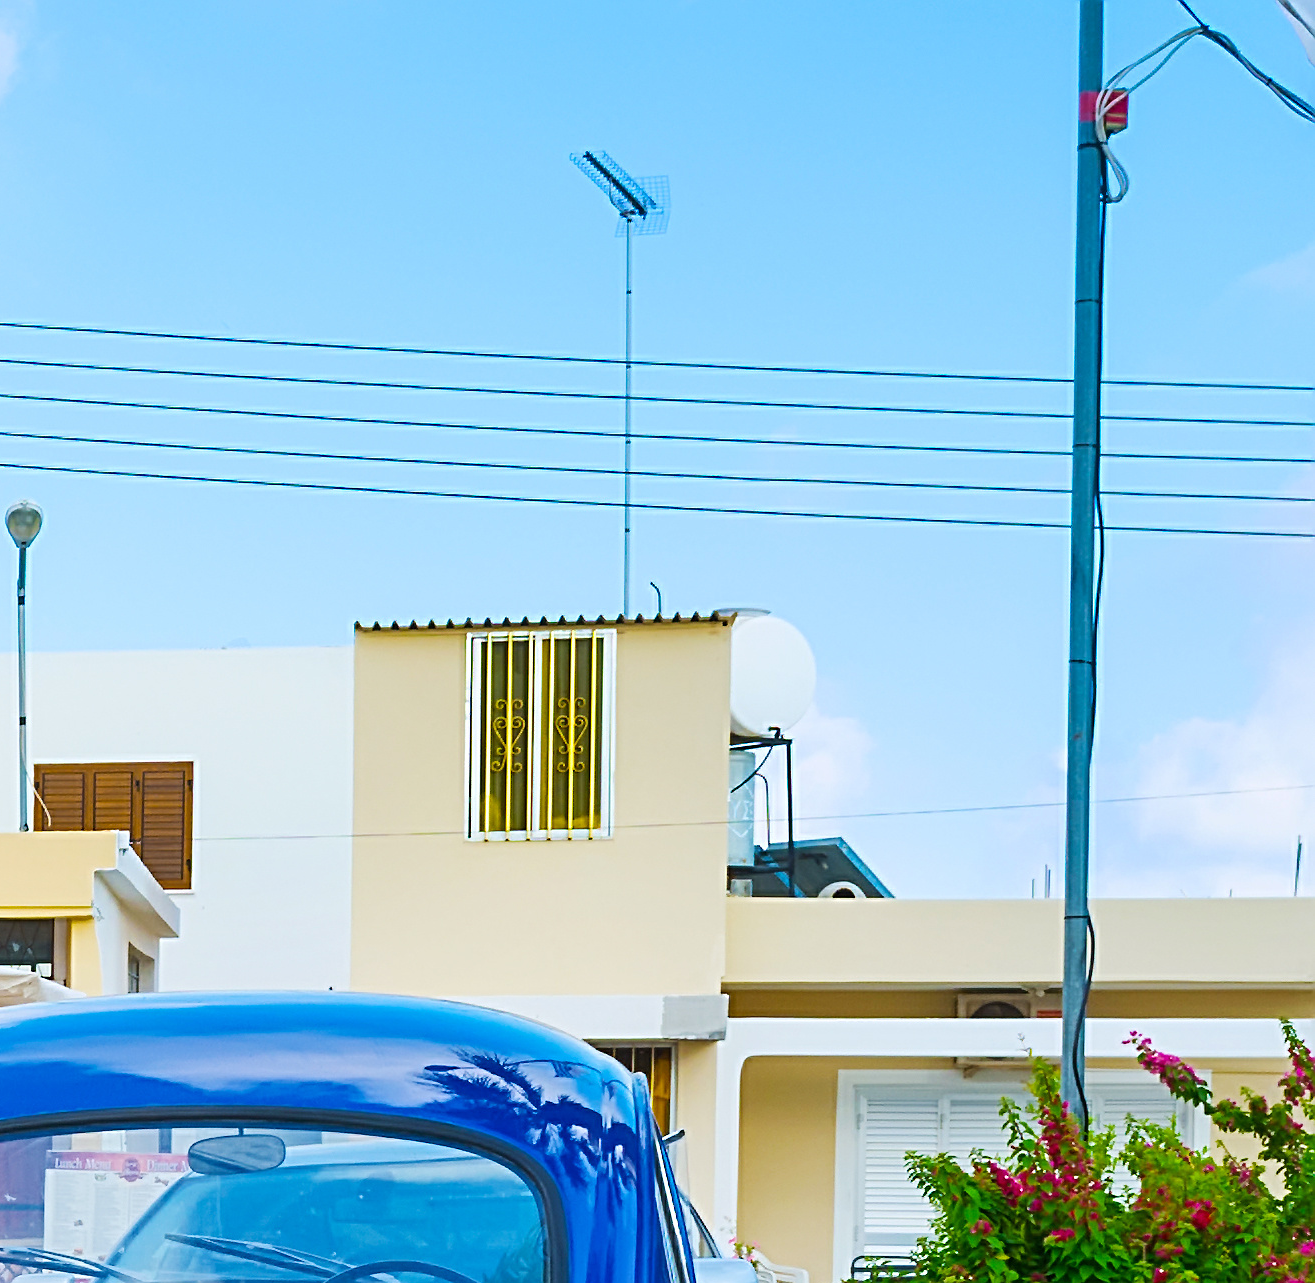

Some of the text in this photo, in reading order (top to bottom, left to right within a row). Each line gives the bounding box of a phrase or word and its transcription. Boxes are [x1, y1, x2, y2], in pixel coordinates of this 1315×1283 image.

[54, 1157, 83, 1169] Lunch
[84, 1158, 112, 1171] Menu
[146, 1159, 179, 1172] Dinner
